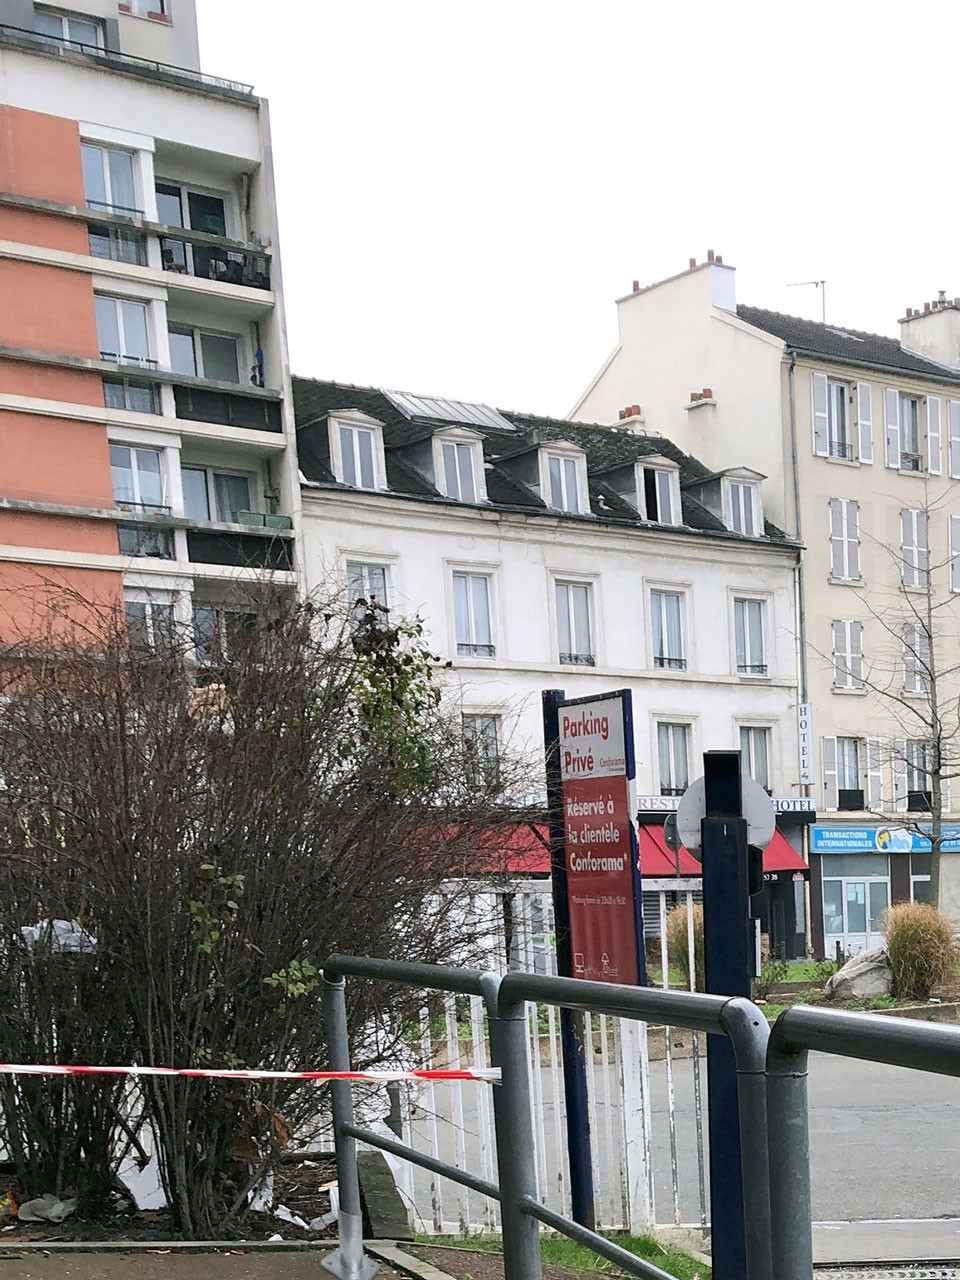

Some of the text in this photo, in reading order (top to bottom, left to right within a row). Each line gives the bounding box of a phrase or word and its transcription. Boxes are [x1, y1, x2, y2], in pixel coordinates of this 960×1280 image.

[563, 710, 609, 740] Parking
[800, 707, 808, 768] HOTEL
[565, 747, 594, 773] Privé
[567, 794, 614, 816] Réservé à
[771, 800, 815, 811] HOTEL
[580, 822, 620, 844] clientèle
[822, 831, 868, 839] TRANSACTIONS
